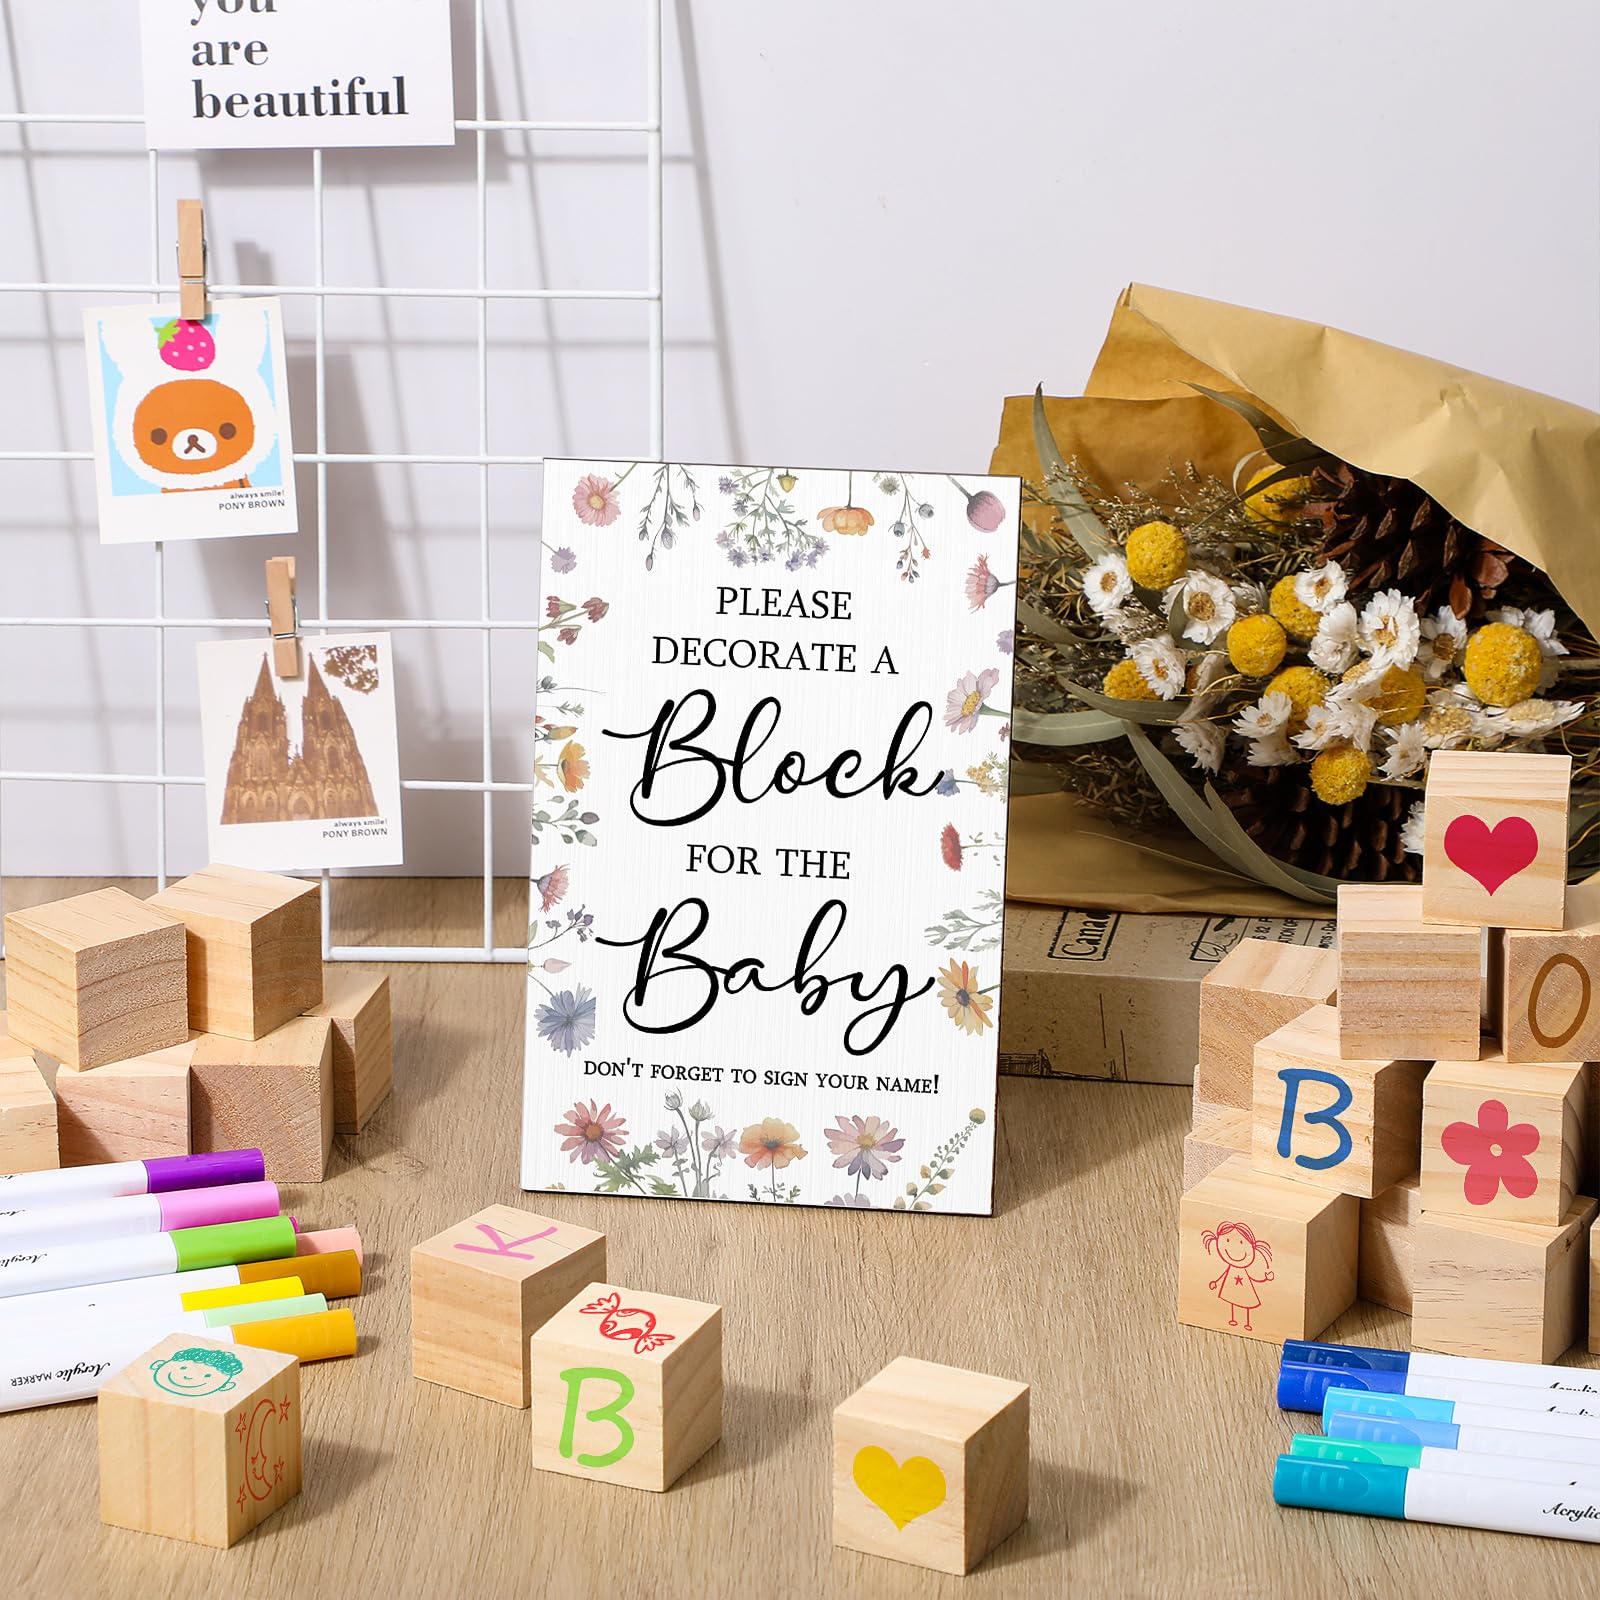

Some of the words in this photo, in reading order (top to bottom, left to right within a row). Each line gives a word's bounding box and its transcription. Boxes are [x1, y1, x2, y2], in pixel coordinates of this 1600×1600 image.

[191, 40, 269, 66] are
[191, 76, 409, 118] beautiful
[218, 502, 246, 510] PONY
[248, 499, 285, 509] BROWN
[715, 586, 852, 620] PLEASE
[651, 636, 857, 673] DECORATE
[870, 645, 899, 675] A
[601, 688, 945, 827] Block
[322, 829, 349, 838] PONY
[351, 827, 388, 837] BROWN
[685, 843, 762, 876] FOR
[775, 848, 851, 880] THE
[594, 897, 936, 1057] Baby
[583, 1057, 644, 1078] DON'T
[650, 1064, 724, 1083] FORGET
[730, 1068, 757, 1084] TO
[763, 1070, 809, 1087] SIGN
[815, 1072, 870, 1091] YOUR
[876, 1074, 939, 1095] NAME!
[1276, 1068, 1353, 1171] B
[0, 1253, 48, 1268] Acryli
[453, 1224, 558, 1261] K
[10, 1371, 52, 1387] MARKER
[55, 1361, 111, 1382] Acrylic
[559, 1367, 636, 1468] B
[1542, 1502, 1600, 1522] Acrylic
